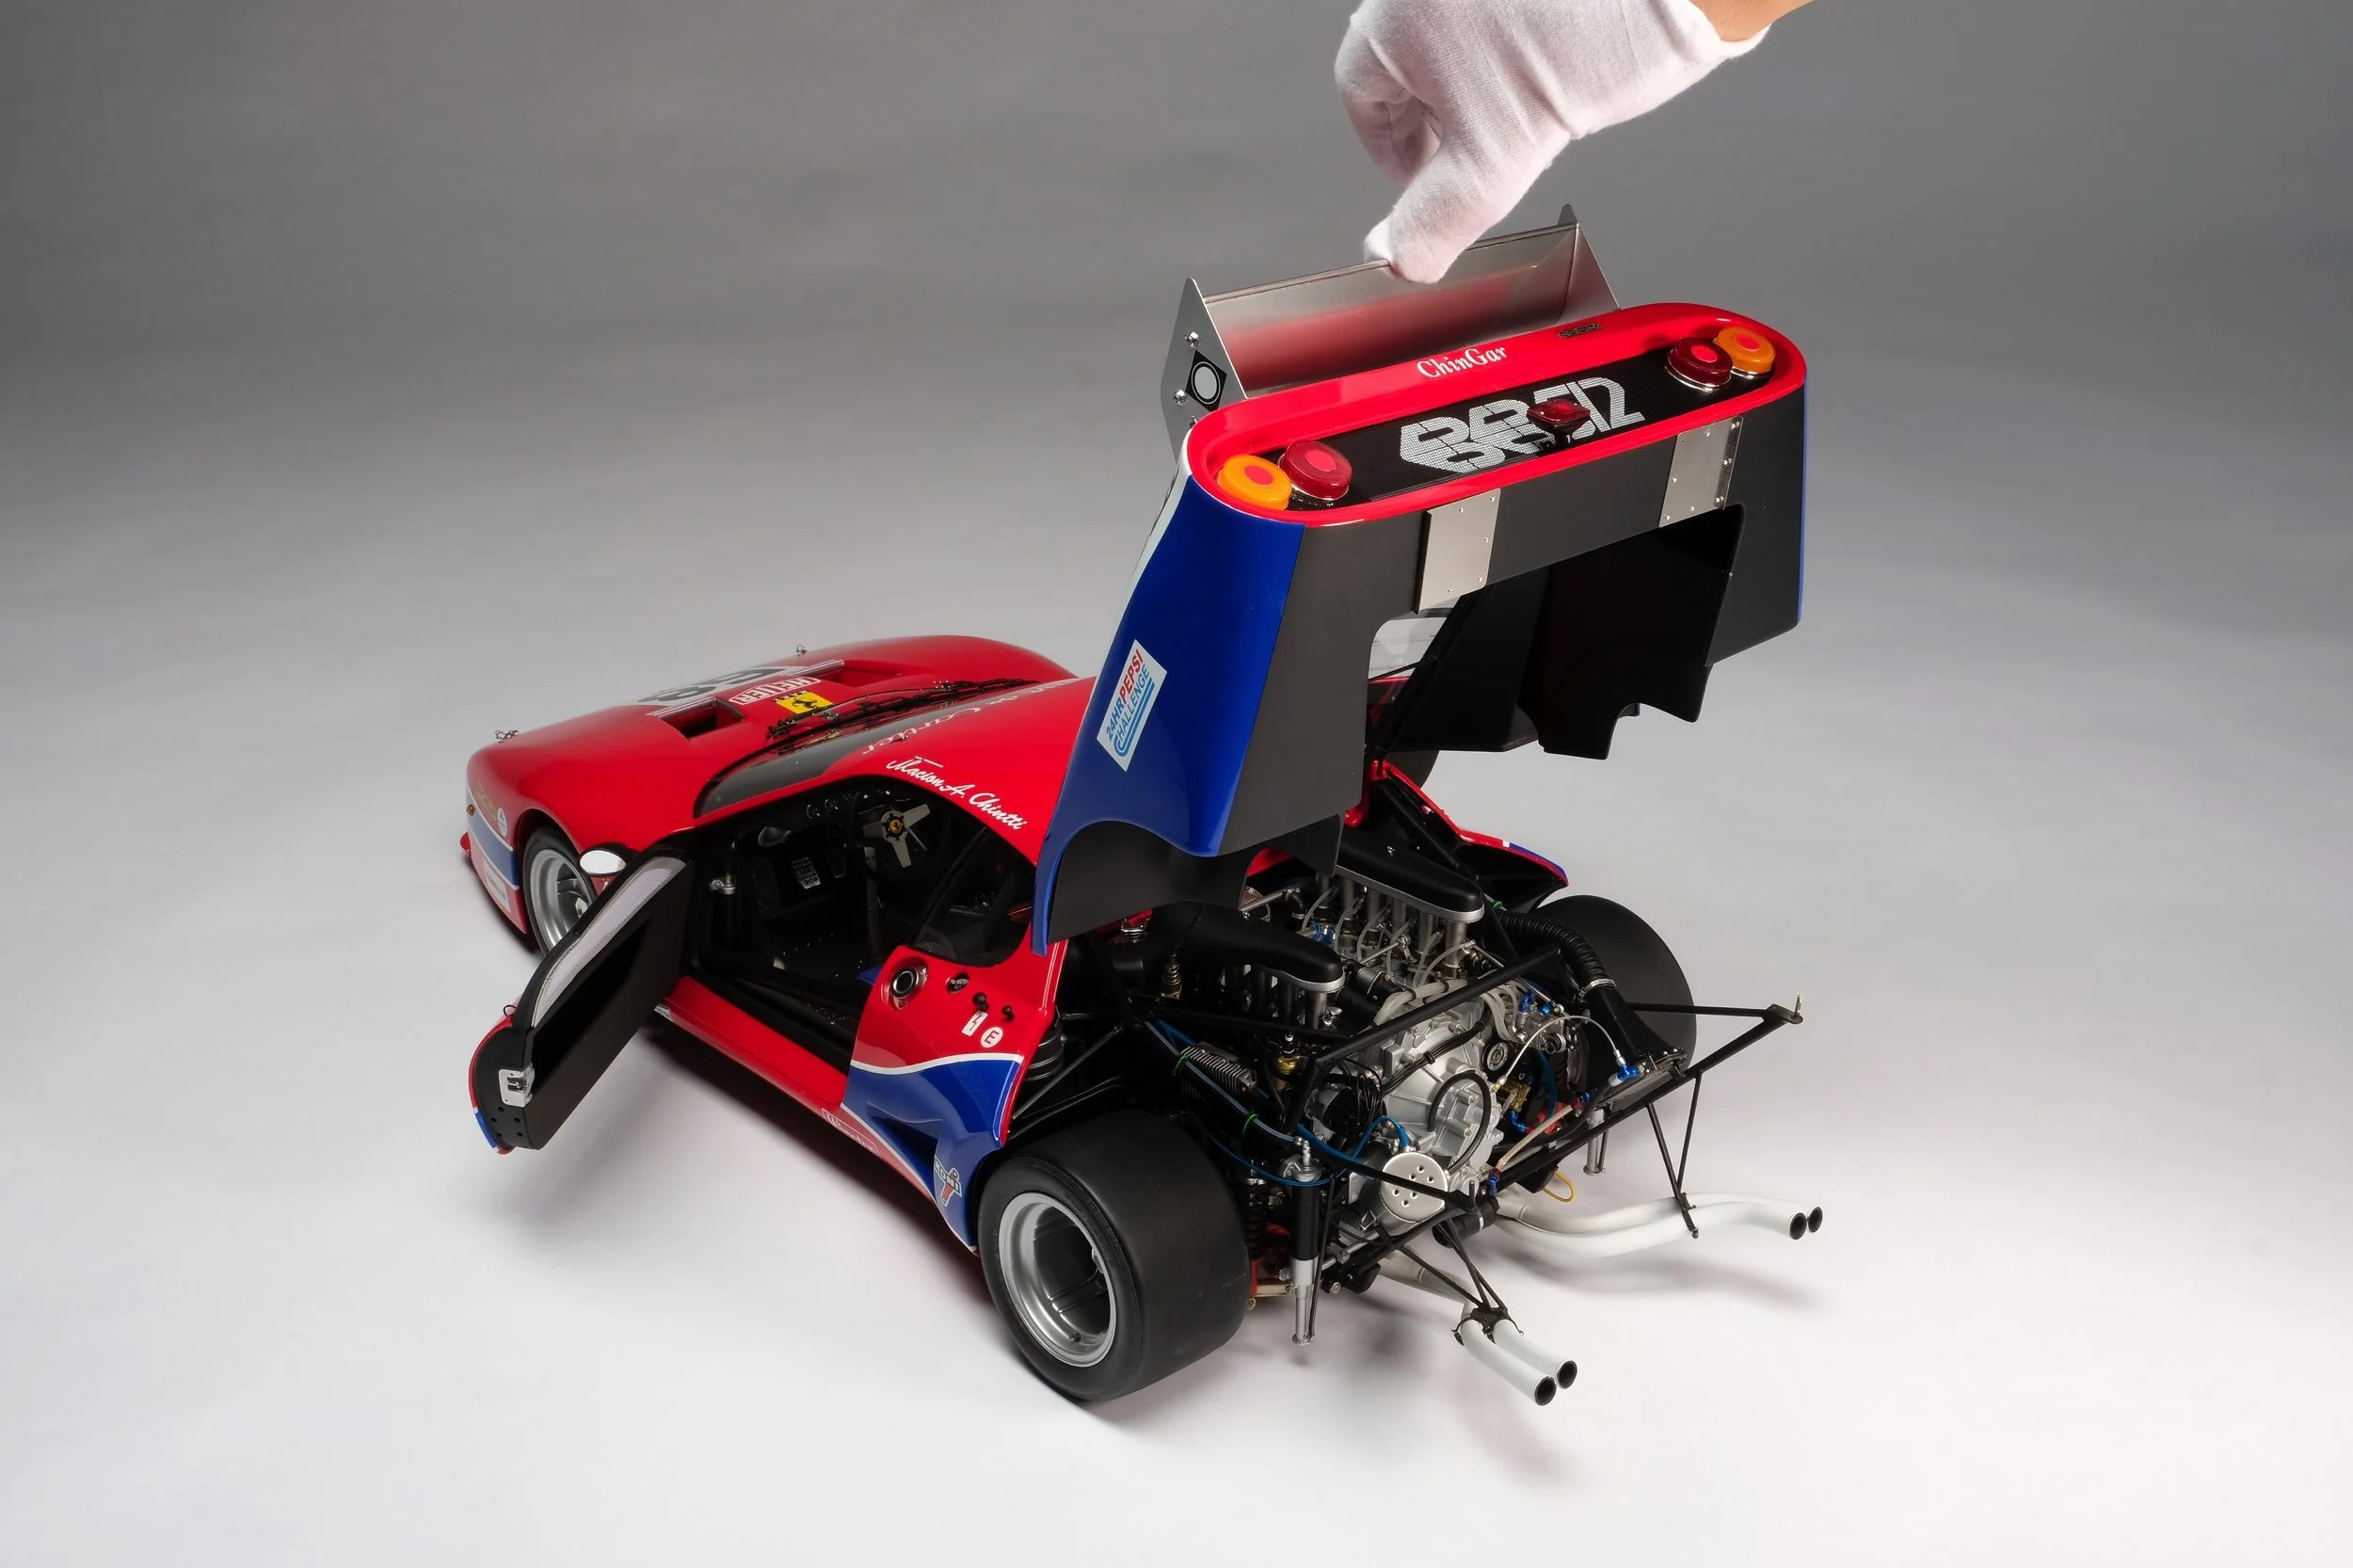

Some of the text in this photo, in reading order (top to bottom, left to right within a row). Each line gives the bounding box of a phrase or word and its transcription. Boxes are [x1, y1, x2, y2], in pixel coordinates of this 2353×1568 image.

[1417, 345, 1508, 378] ChinGar
[735, 677, 812, 705] HEUER
[1113, 664, 1154, 757] CHALLENGE
[984, 1030, 1000, 1046] E
